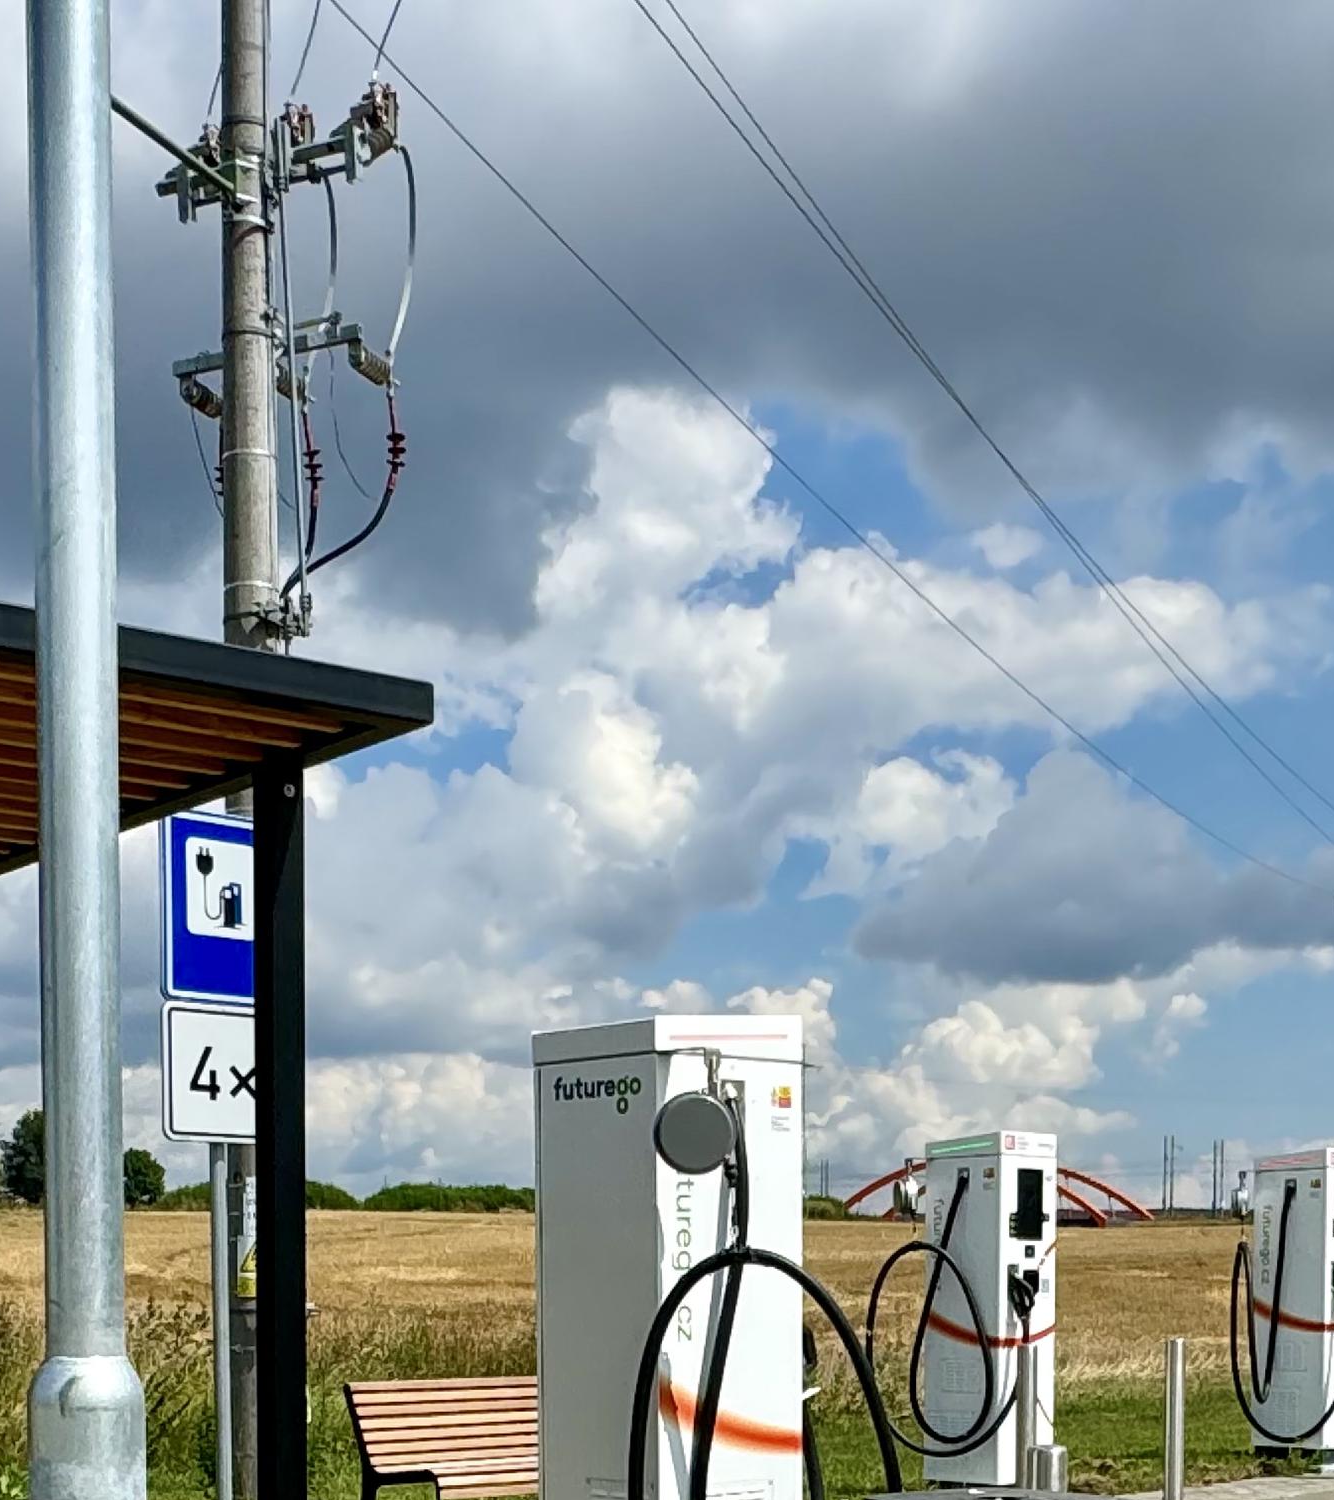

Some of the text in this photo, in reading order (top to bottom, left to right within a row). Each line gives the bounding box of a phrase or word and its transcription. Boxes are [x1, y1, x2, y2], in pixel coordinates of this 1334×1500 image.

[554, 1075, 641, 1114] futurego
[672, 1178, 694, 1341] turegcz
[1260, 1205, 1273, 1284] futuregocz
